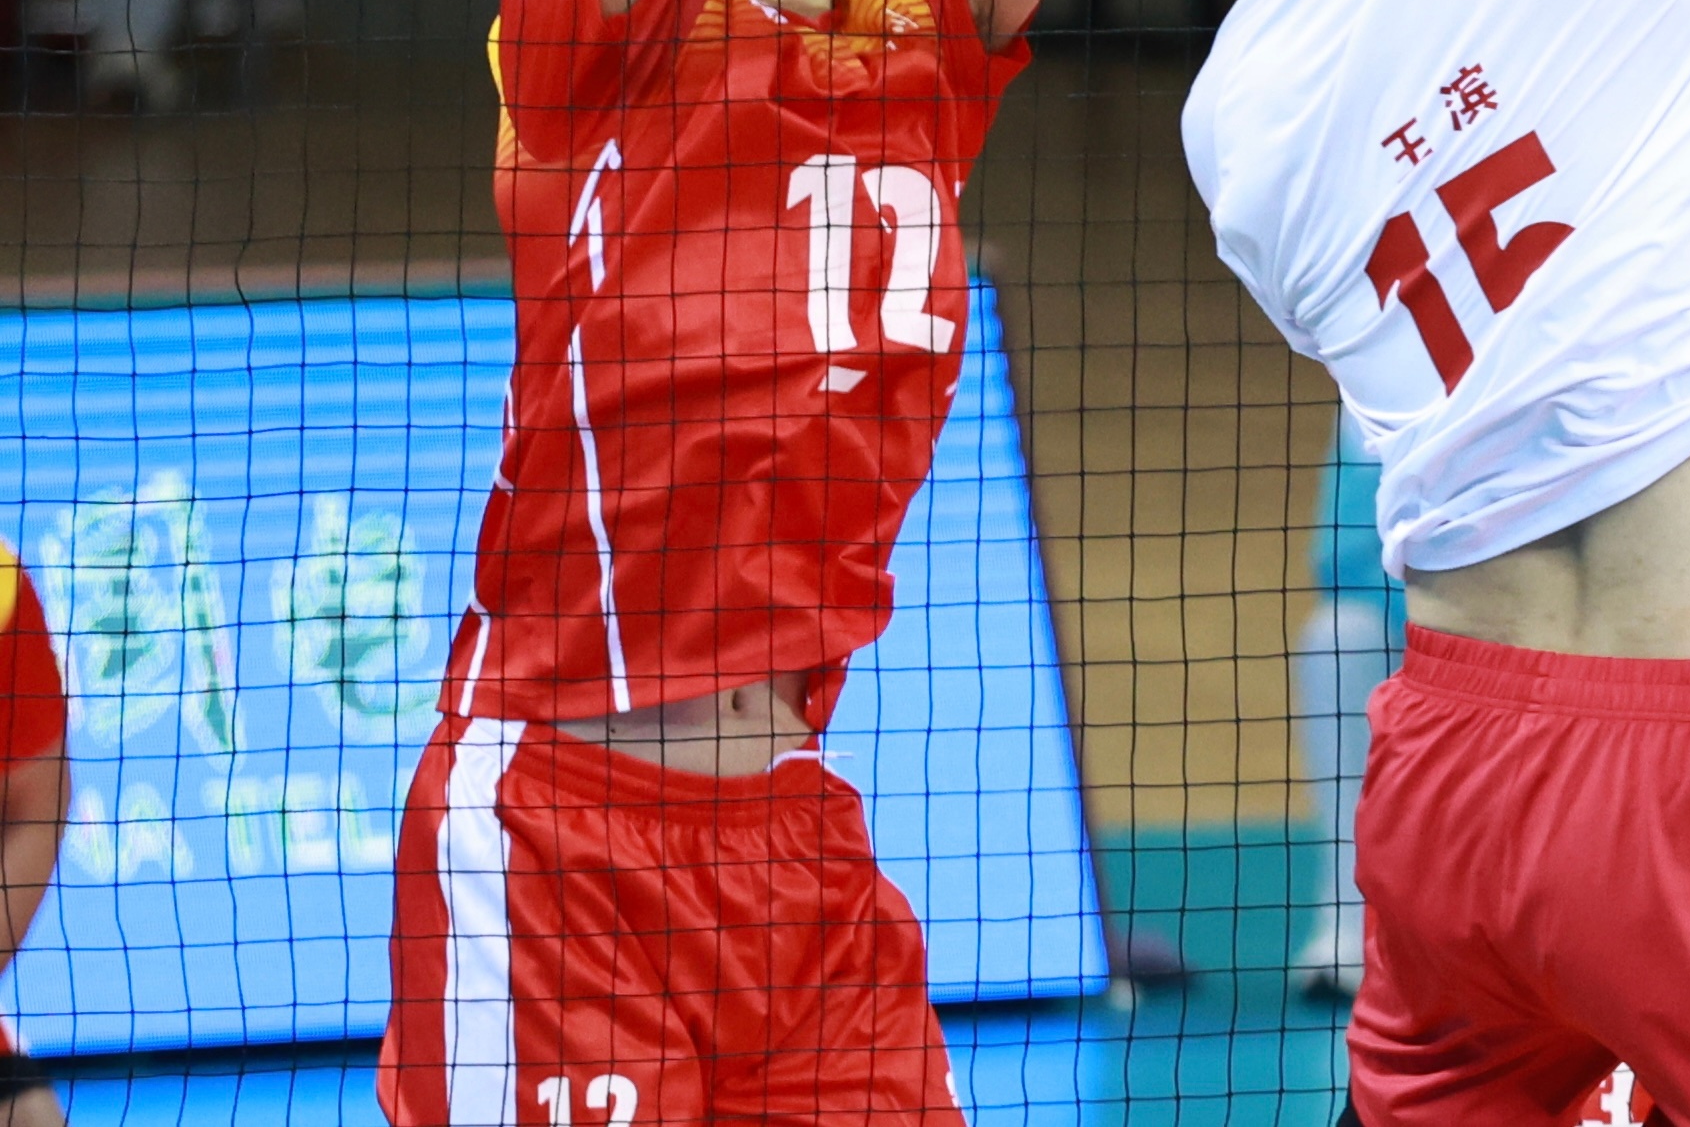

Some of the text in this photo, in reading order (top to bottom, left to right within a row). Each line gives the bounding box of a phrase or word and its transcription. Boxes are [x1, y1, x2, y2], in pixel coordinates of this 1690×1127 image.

[1380, 63, 1499, 170] 王滨
[786, 154, 956, 355] 12
[1364, 129, 1577, 398] 15
[205, 769, 414, 873] TEL
